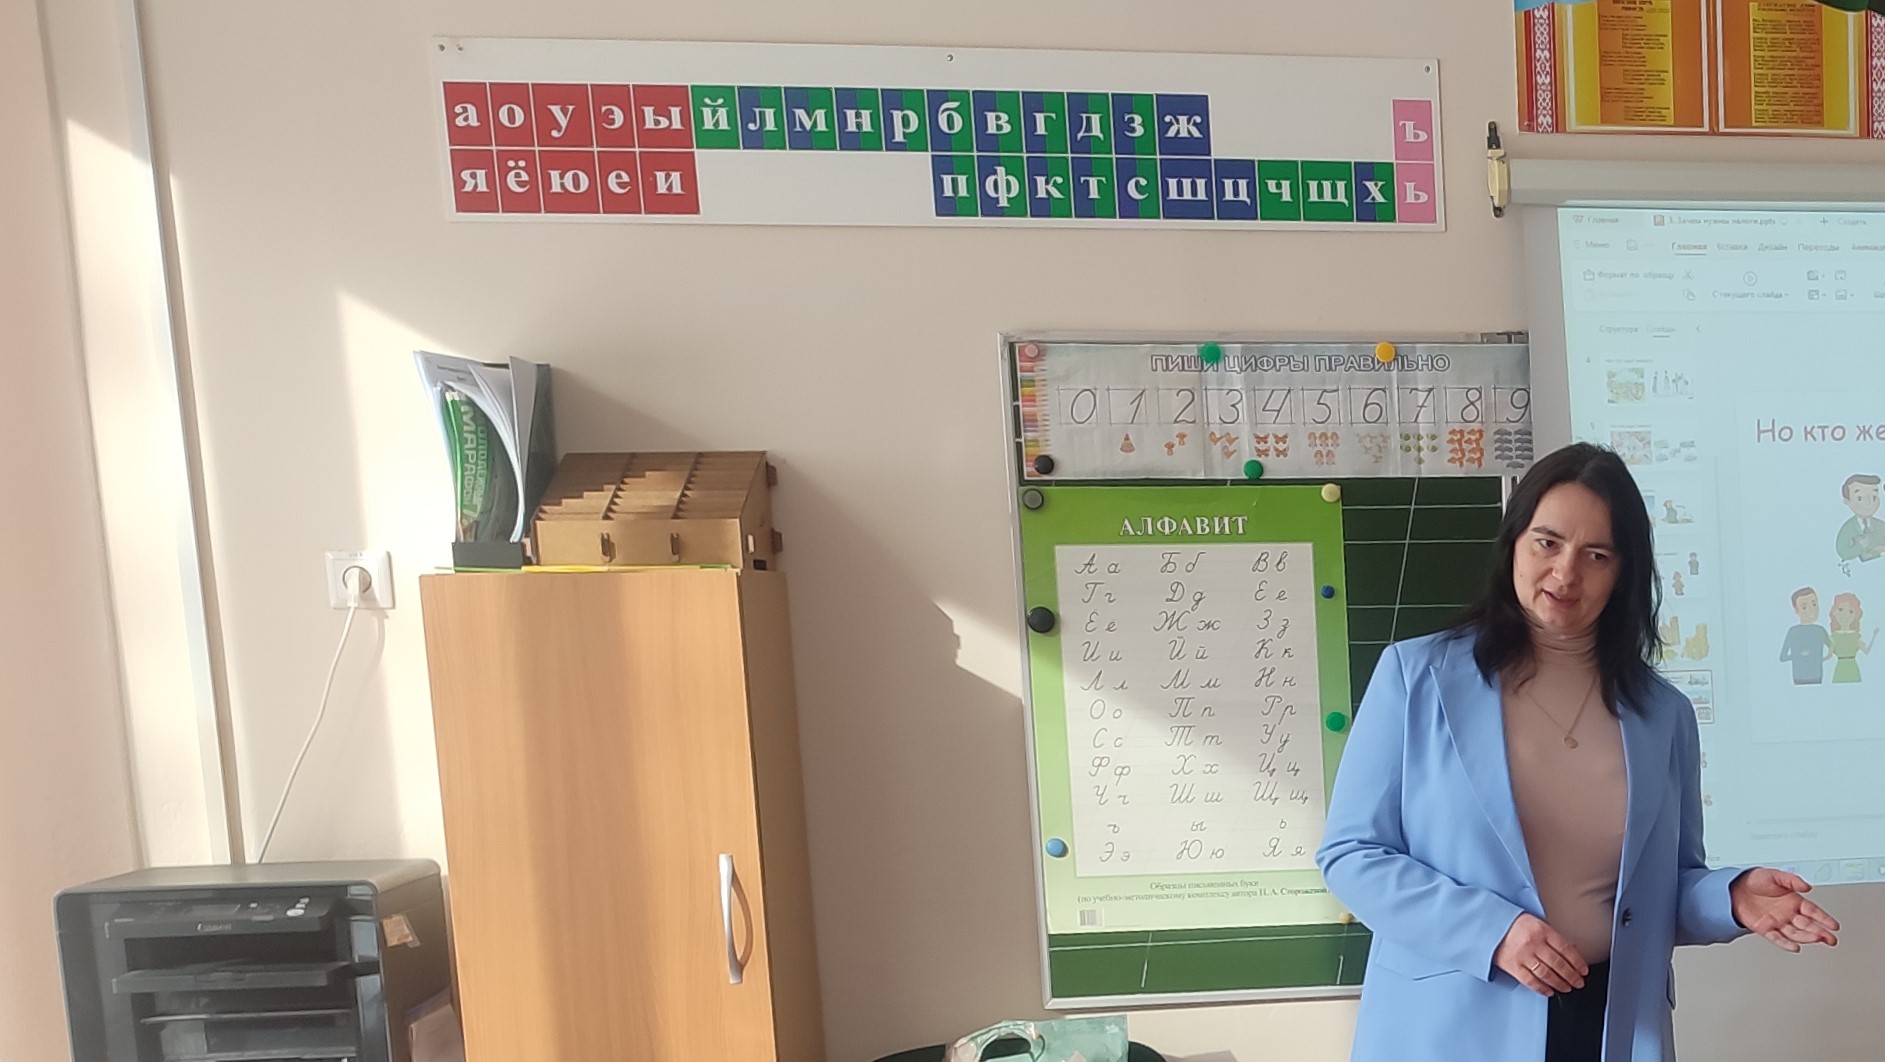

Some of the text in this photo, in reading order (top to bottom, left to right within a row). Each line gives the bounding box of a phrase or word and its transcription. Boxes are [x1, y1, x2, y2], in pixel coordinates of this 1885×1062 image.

[455, 97, 1428, 143] а о у э ы й л м н р б в г д з ж ъ
[461, 160, 1428, 207] я ё ю е и п ф к т с ш ц ч щ х ь
[1224, 354, 1310, 373] ЦИФРЫ
[1070, 388, 1531, 425] 0 1 2 3 4 5 6 7 8 9
[1755, 419, 1794, 443] Но
[1803, 422, 1847, 442] кто
[1119, 516, 1248, 536] АЛФАВИТ
